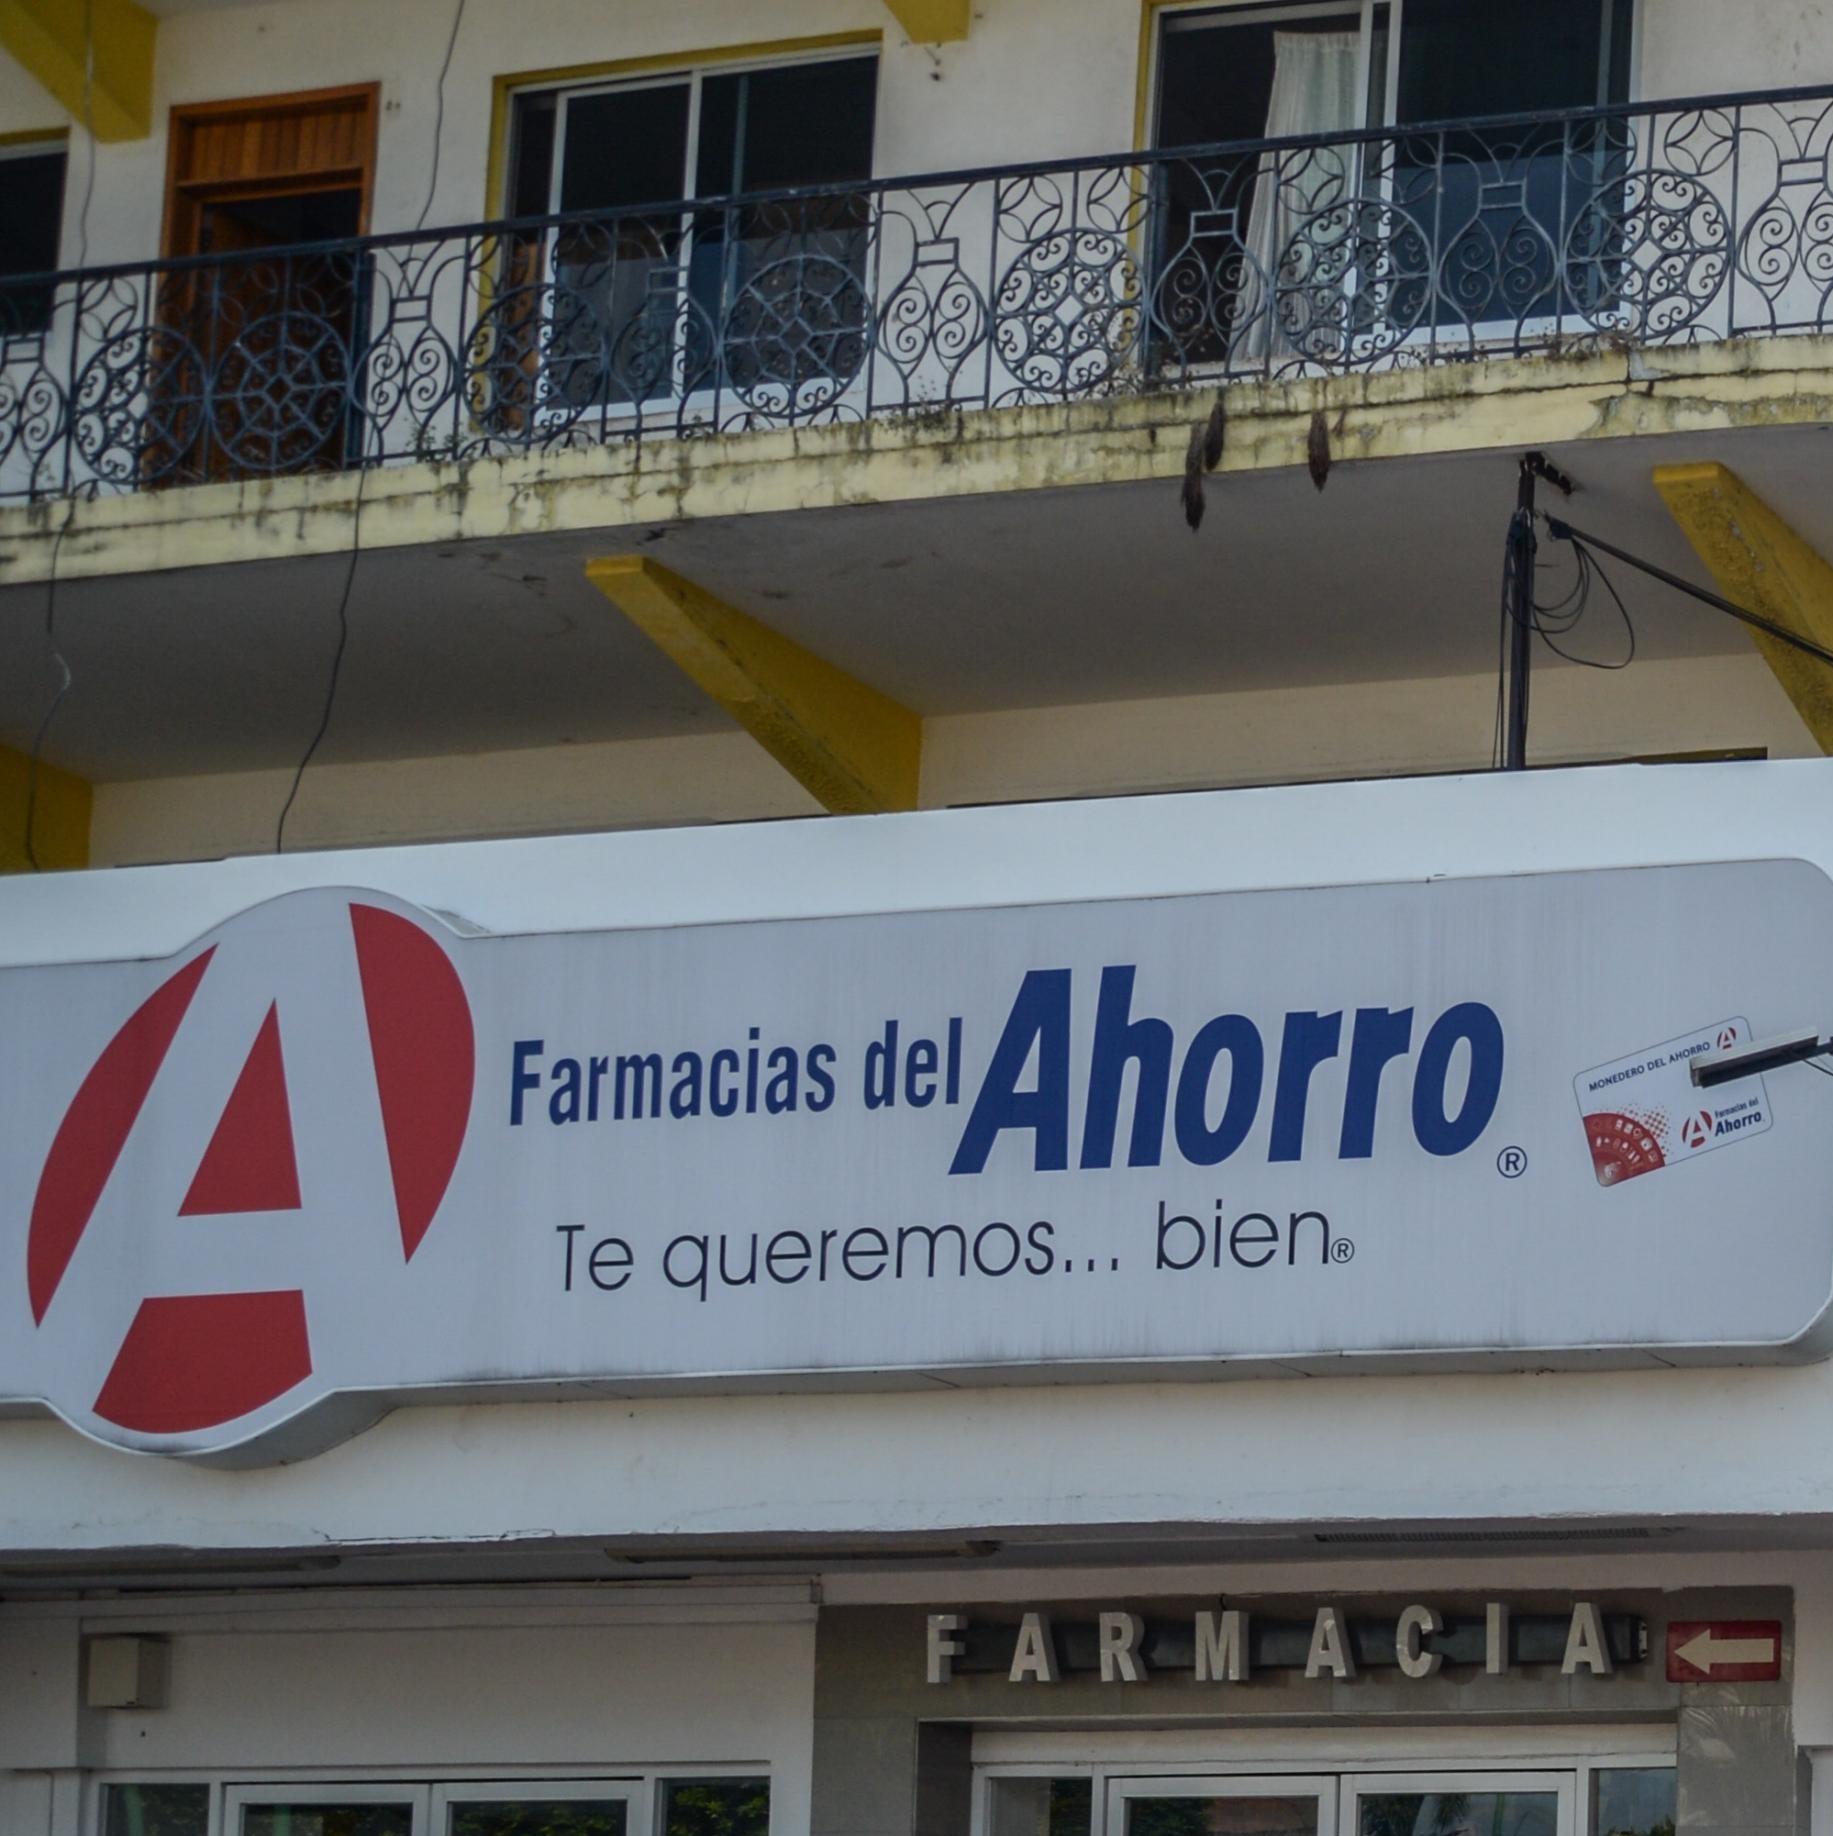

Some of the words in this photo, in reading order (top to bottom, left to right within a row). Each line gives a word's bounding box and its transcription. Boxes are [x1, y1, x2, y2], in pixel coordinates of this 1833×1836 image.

[509, 1027, 836, 1127] Farmacias
[862, 1016, 963, 1111] del
[948, 964, 1506, 1177] Ahorro
[1588, 1064, 1645, 1092] MONEDERO
[1647, 1058, 1666, 1073] DEL
[1668, 1041, 1711, 1064] AHORRO
[1714, 1111, 1762, 1137] Ahorro
[555, 1223, 634, 1293] Te
[663, 1219, 1118, 1303] queremos...
[1157, 1199, 1330, 1272] bien
[926, 1602, 1613, 1684] FARMACIA
